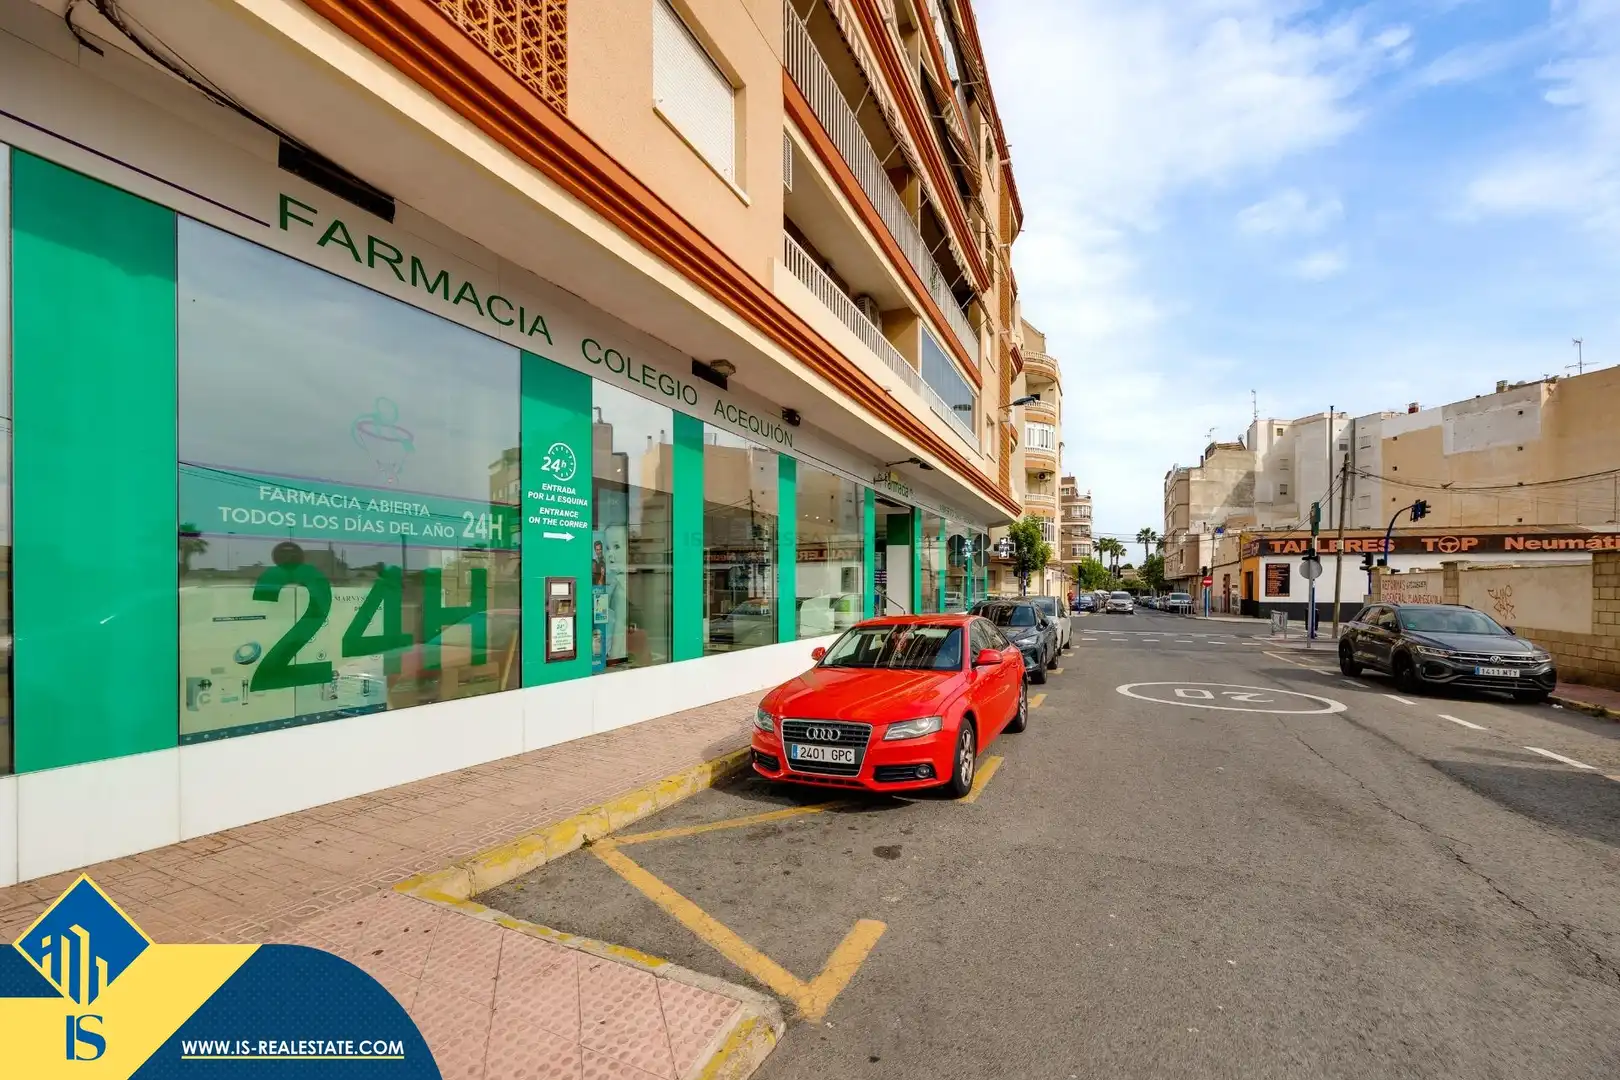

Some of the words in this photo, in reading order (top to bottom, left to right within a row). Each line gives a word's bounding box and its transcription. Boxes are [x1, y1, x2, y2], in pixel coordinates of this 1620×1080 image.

[279, 192, 554, 346] FARMACIA
[581, 338, 698, 406] COLEGIO
[713, 399, 793, 448] ACEQUIÓN
[541, 456, 567, 472] 24h
[542, 483, 576, 495] ENTRADA
[259, 485, 361, 511] FARMACIA
[366, 498, 431, 517] ABIERTA
[527, 491, 545, 501] POR
[545, 493, 556, 502] LA
[557, 495, 588, 506] ESQUINA
[539, 507, 579, 518] ENTRANCE
[218, 506, 297, 527] TODOS
[303, 513, 339, 530] LOS
[344, 514, 385, 533] DÍAS
[389, 520, 418, 536] DEL
[422, 522, 455, 538] AÑO
[462, 510, 503, 541] 24H
[528, 516, 541, 525] ON
[542, 517, 558, 526] THE
[559, 520, 588, 529] CORNER
[1269, 538, 1396, 553] TALLERES
[1421, 536, 1479, 553] TOP
[250, 563, 488, 692] 24H
[800, 746, 826, 760] 2401
[831, 748, 853, 762] GPC
